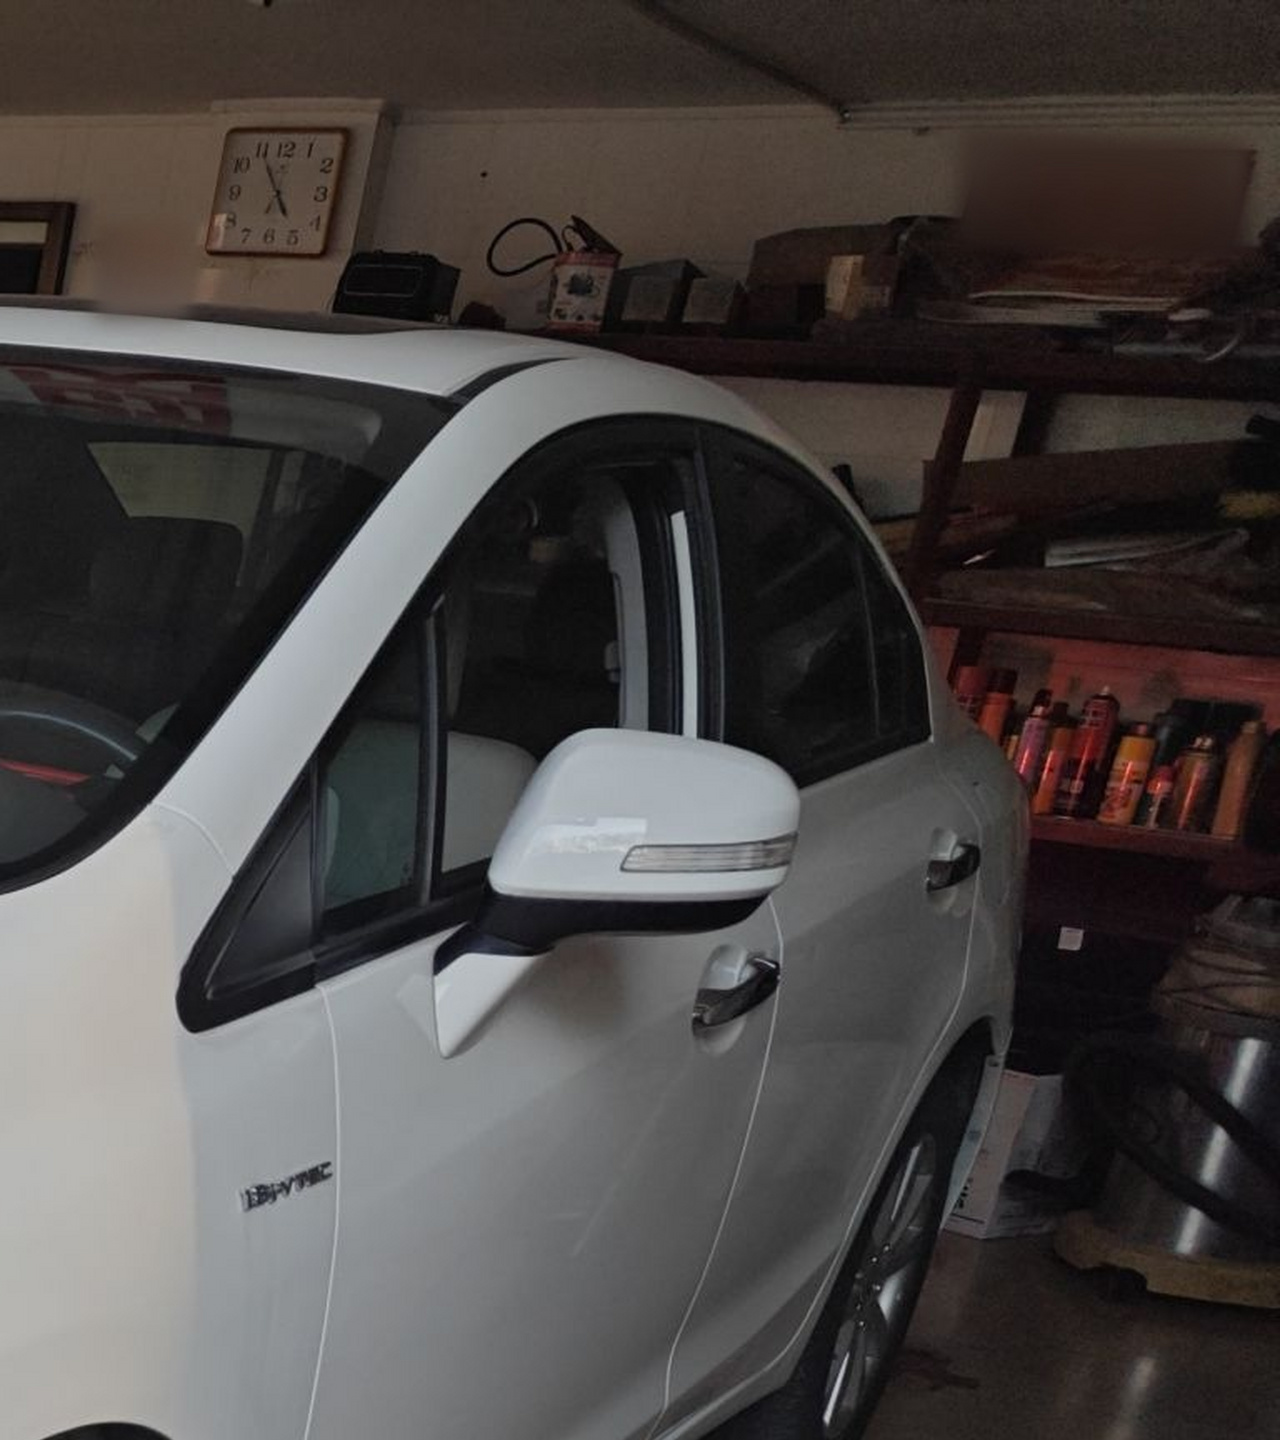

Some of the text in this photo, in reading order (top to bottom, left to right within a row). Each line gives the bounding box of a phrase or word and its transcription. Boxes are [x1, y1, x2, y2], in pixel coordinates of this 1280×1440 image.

[255, 141, 315, 159] 11 12 1
[233, 157, 251, 174] 10
[320, 158, 334, 174] 2
[228, 186, 242, 201] 9
[314, 186, 328, 202] 3
[226, 213, 237, 229] 8
[309, 216, 321, 232] 4
[242, 228, 299, 246] 7 6 5
